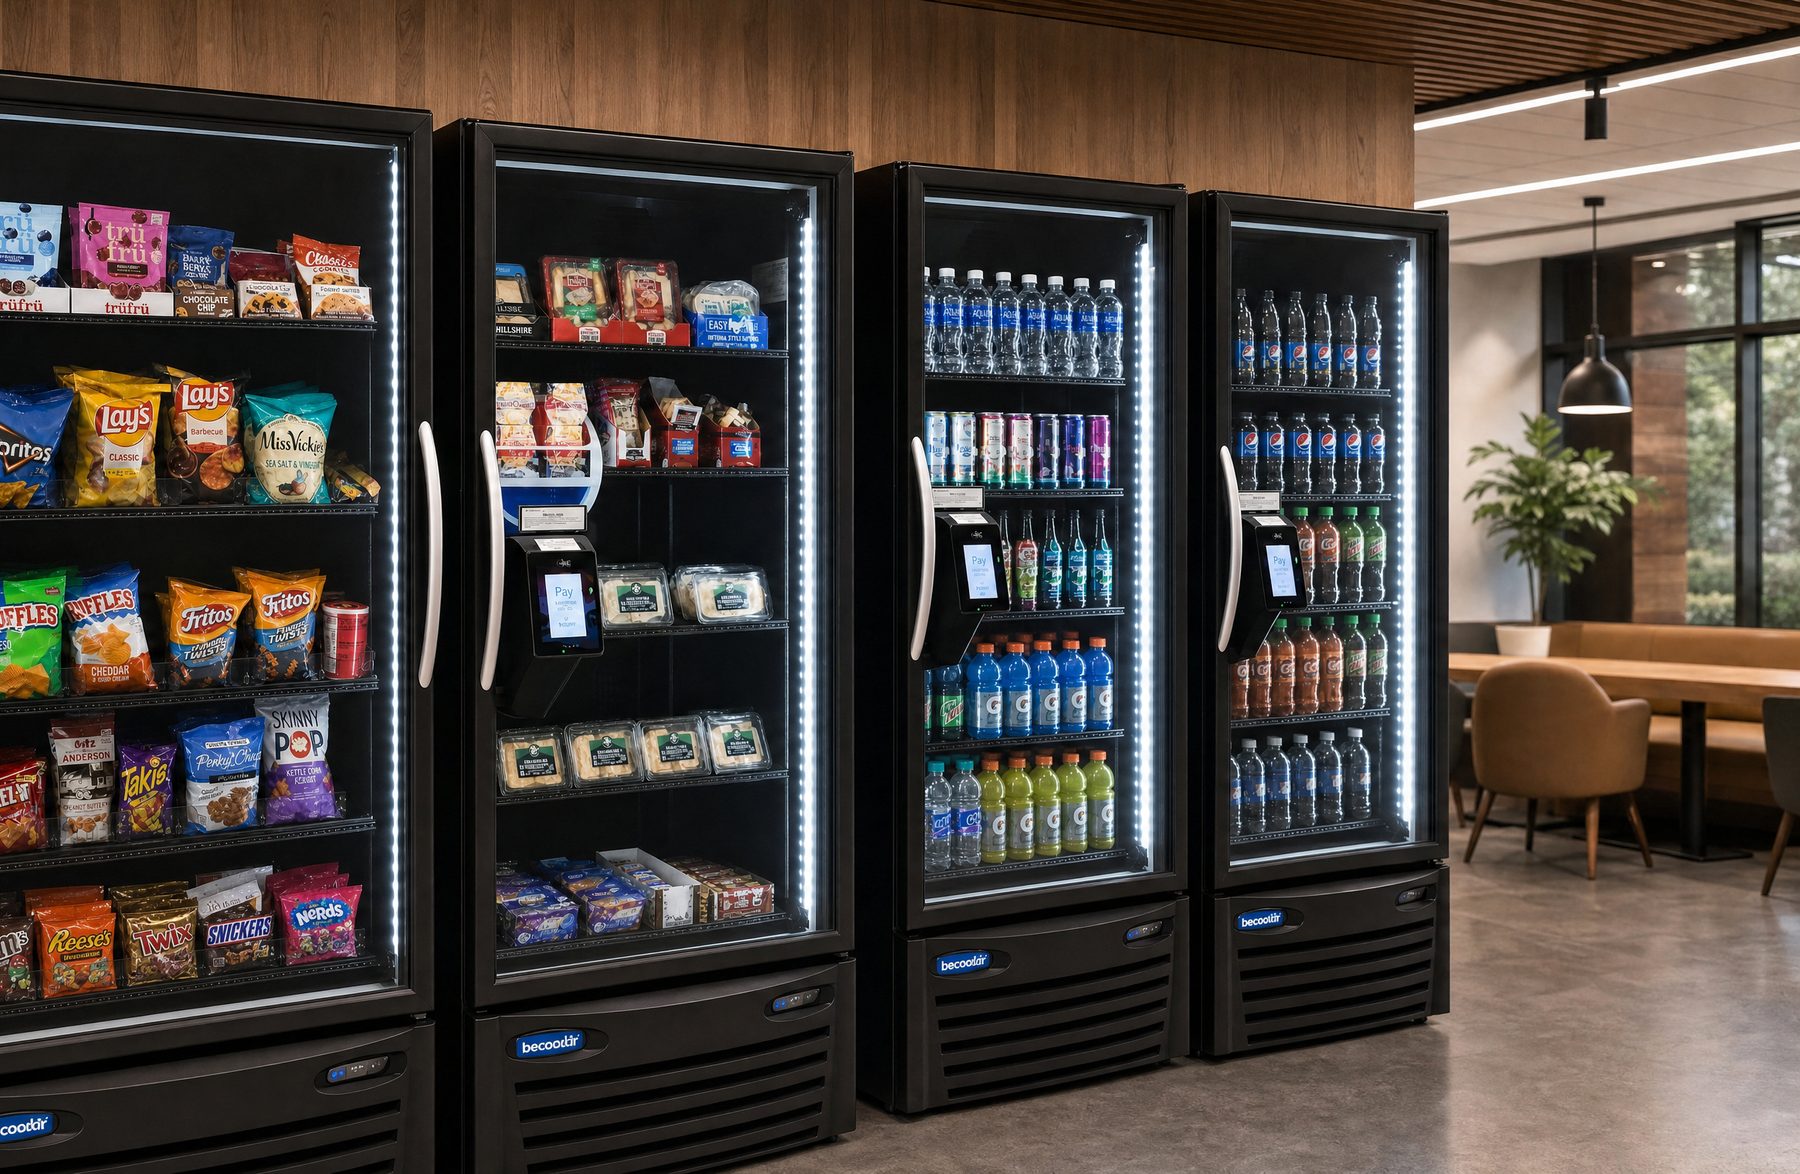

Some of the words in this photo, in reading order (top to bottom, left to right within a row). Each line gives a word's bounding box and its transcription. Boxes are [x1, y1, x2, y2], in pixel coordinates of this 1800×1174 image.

[0, 213, 34, 232] rü
[0, 298, 44, 312] rüfrü
[183, 295, 229, 305] CHOCOLATE
[197, 303, 216, 312] CHIP
[105, 302, 149, 315] trüfrü
[496, 326, 533, 334] HILLSHIRE
[182, 383, 230, 410] Lay's
[101, 404, 150, 434] Lay's
[190, 427, 224, 436] Barbecue
[259, 431, 291, 451] Miss
[0, 440, 52, 462] oritos
[109, 453, 140, 461] CLASSIC
[265, 459, 277, 468] SEA
[277, 459, 292, 468] SALT
[971, 556, 987, 567] Pay
[1273, 555, 1286, 567] Pay
[555, 586, 574, 599] Pay
[260, 591, 311, 618] Fritos
[0, 604, 58, 628] FFLES
[180, 603, 235, 633] Fritos
[91, 664, 130, 677] CHEDDAR
[271, 709, 319, 729] SKINNY
[274, 729, 324, 760] POP
[62, 751, 111, 763] ANDERSON
[121, 762, 168, 802] Takis
[207, 917, 271, 946] SNICKERS
[49, 929, 112, 954] Reese's
